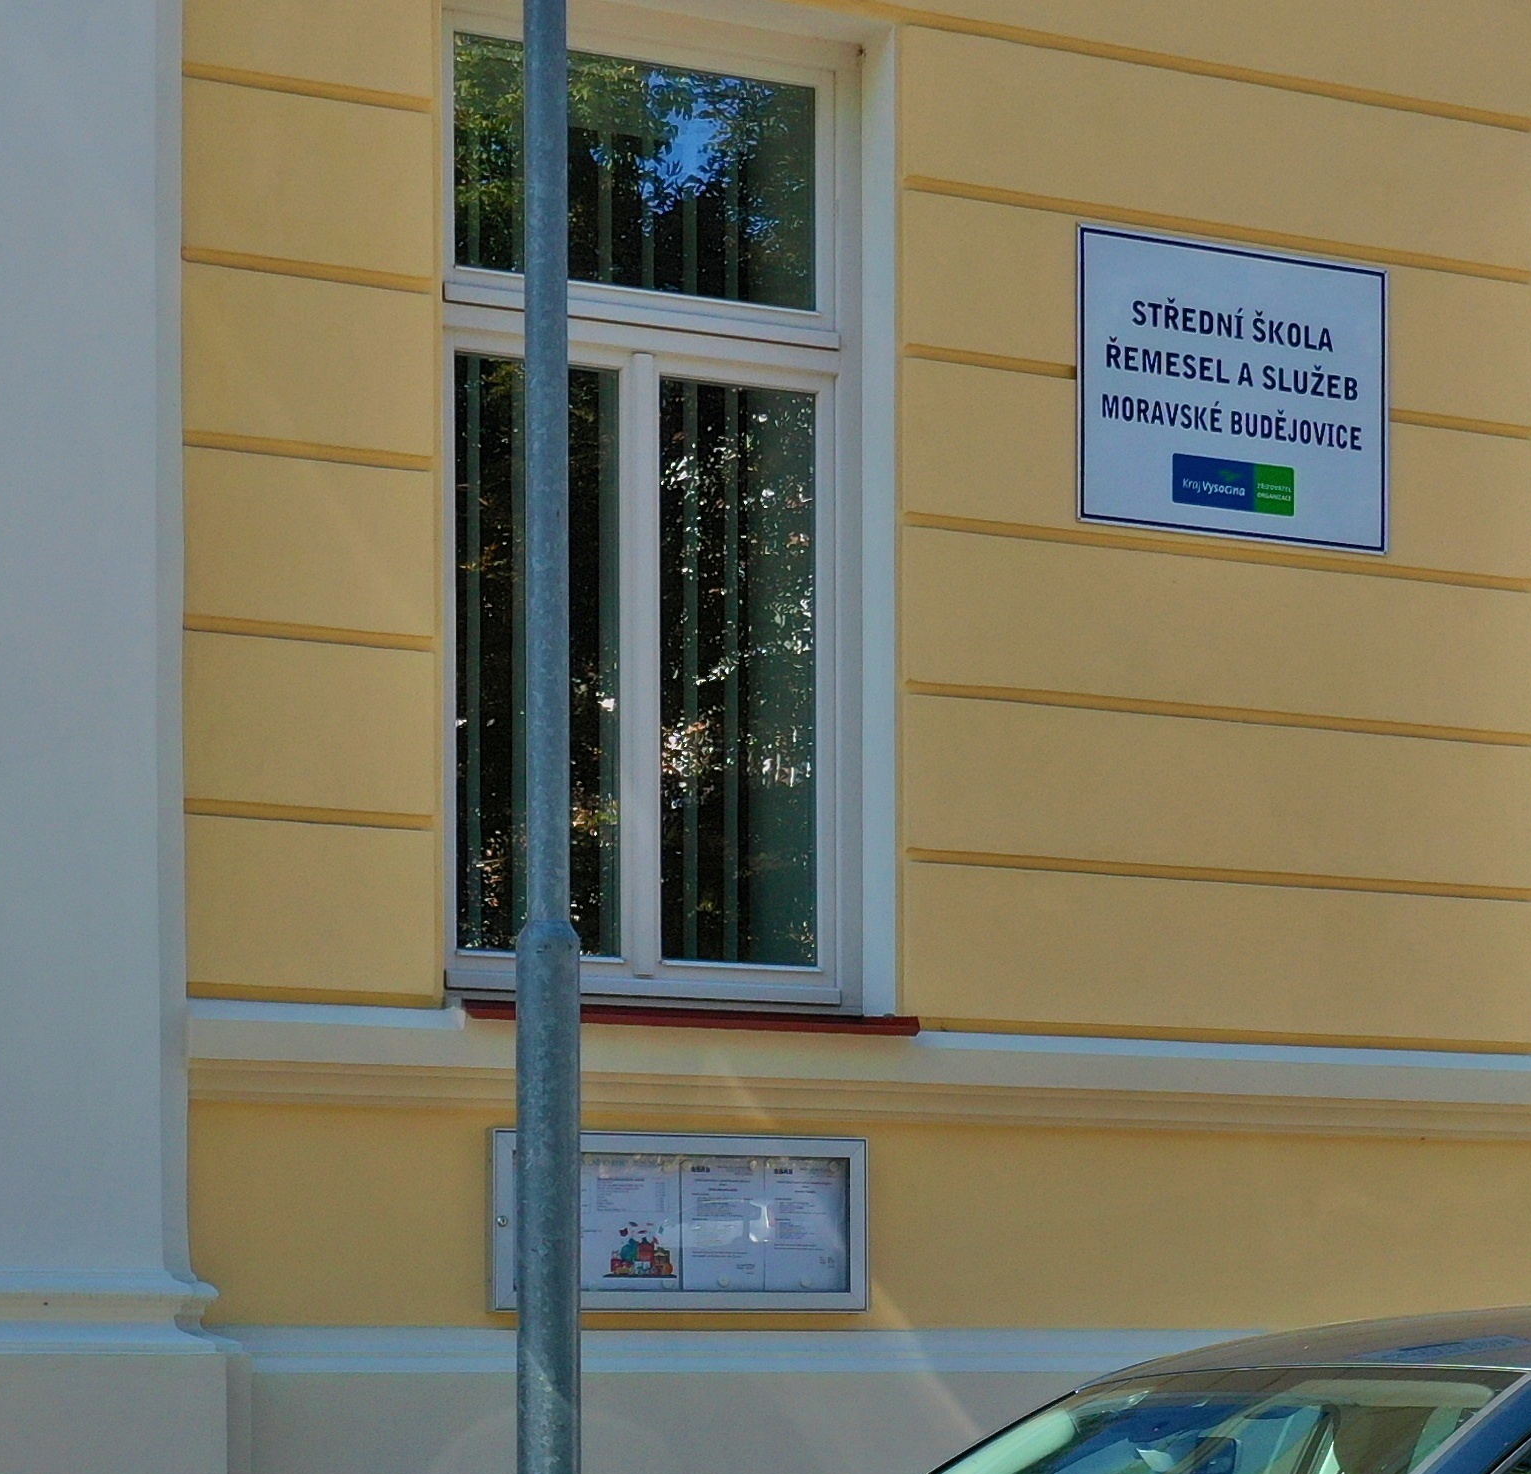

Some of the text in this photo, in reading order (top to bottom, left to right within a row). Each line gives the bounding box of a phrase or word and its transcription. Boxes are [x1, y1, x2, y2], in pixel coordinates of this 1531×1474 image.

[1131, 297, 1334, 352] STŘEDNÍ ŠKOLA
[1105, 336, 1359, 401] ŘEMESEL A SLUŽEB
[1101, 393, 1363, 451] MORAVSKÉ BUDĚJOVICE
[1181, 478, 1201, 493] Kraj
